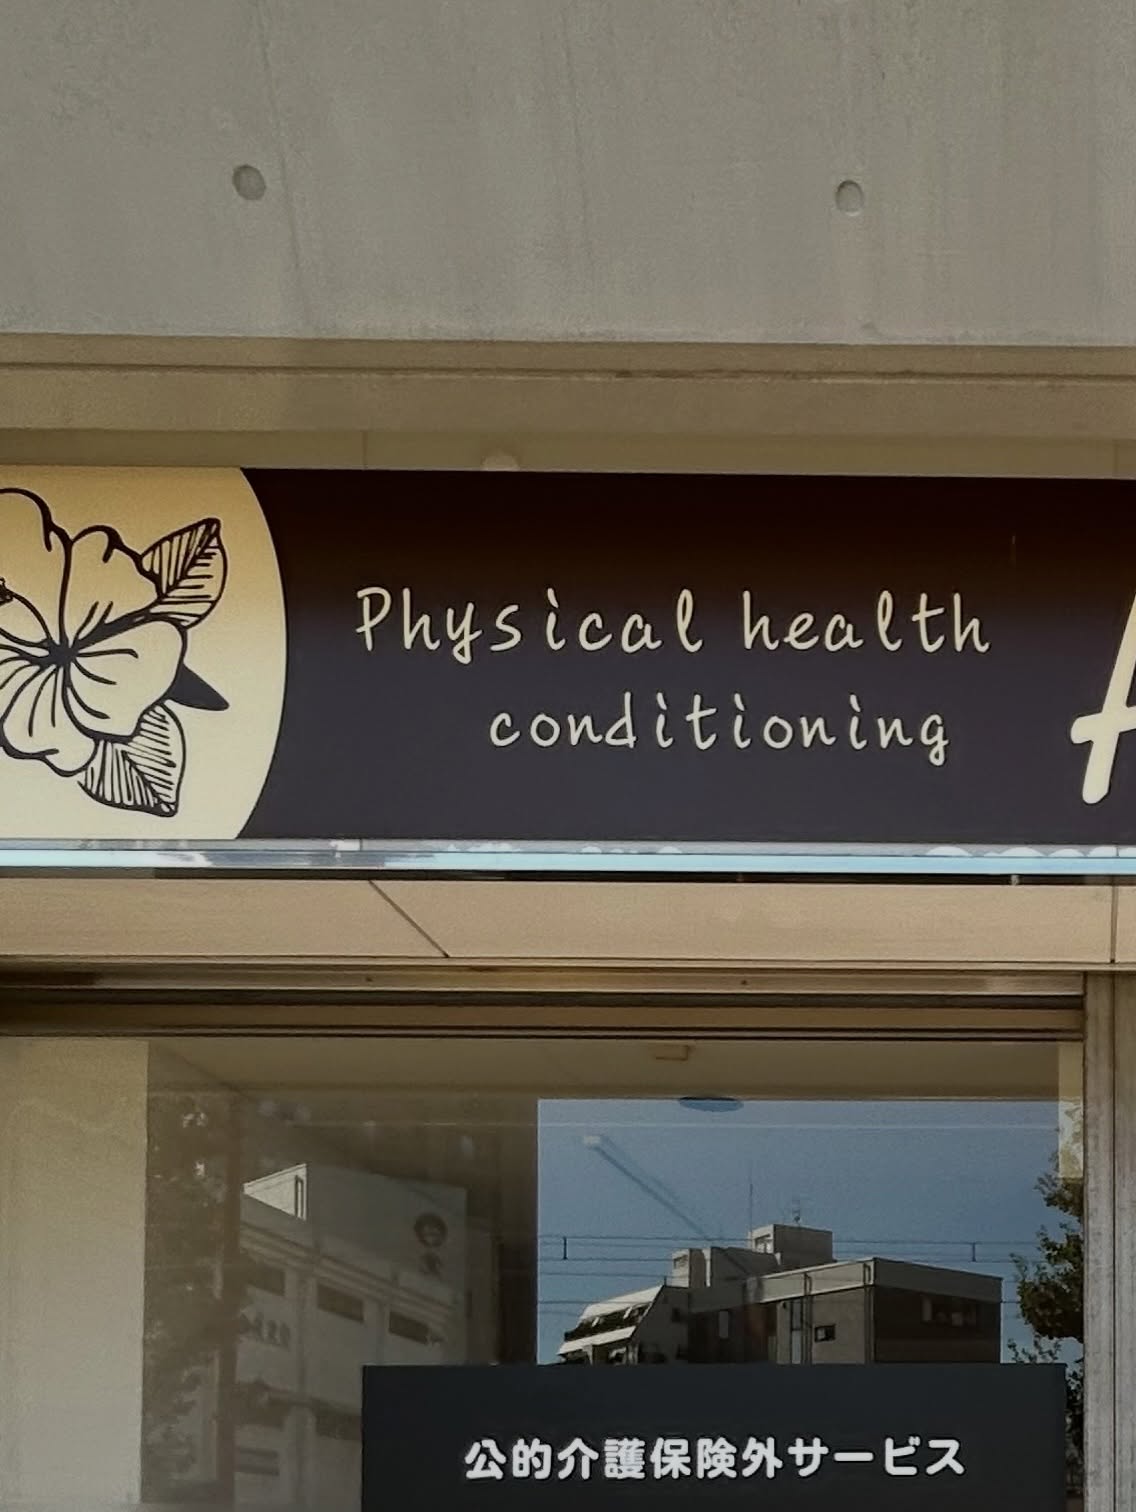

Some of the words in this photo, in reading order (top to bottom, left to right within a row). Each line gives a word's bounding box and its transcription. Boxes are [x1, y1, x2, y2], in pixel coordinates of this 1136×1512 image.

[355, 586, 703, 665] Physical
[742, 590, 990, 653] health
[489, 691, 949, 766] conditioning
[464, 1436, 966, 1480] 公的介護保険外サービス
